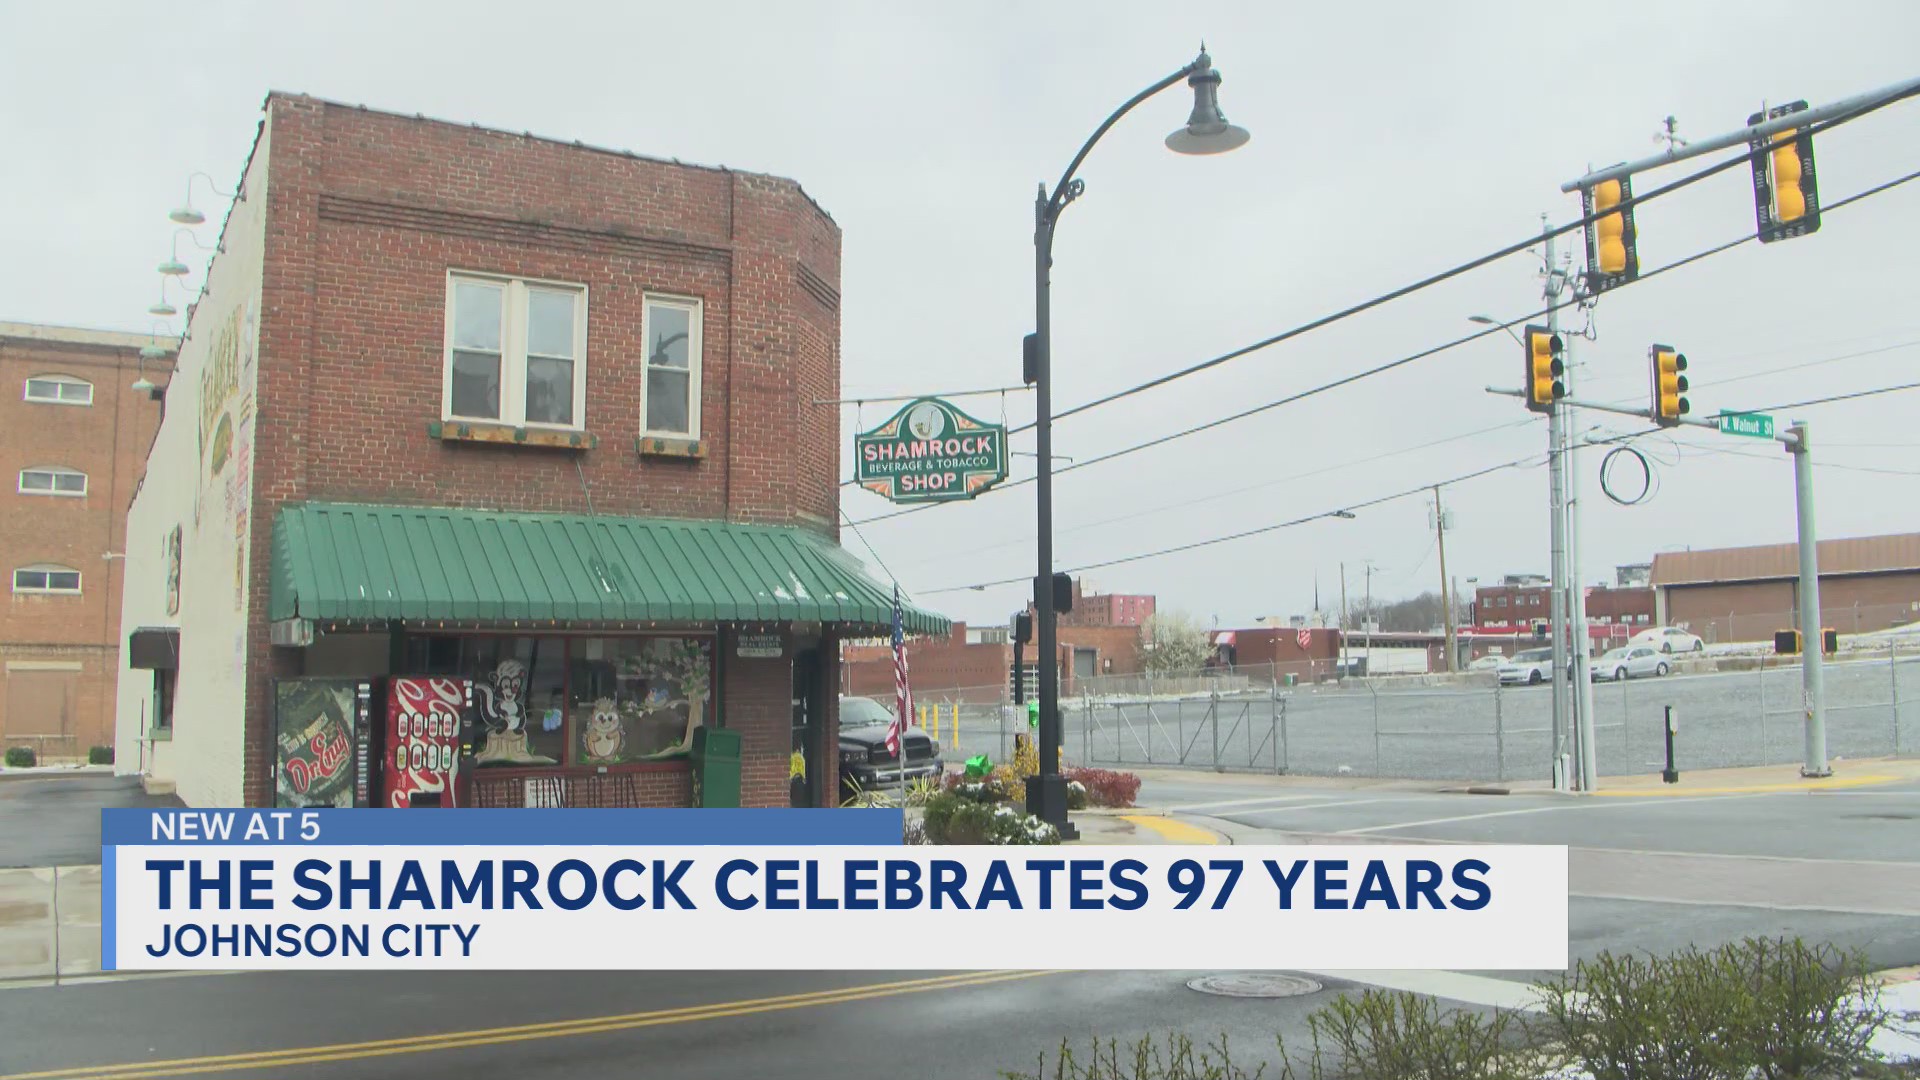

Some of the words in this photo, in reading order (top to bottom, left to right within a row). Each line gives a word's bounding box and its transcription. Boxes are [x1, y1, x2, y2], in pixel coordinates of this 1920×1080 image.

[1731, 415, 1760, 433] Walnut
[1764, 420, 1773, 435] St
[864, 436, 993, 462] SHAMROCK
[869, 461, 923, 473] BEVERAGE
[926, 460, 934, 470] &
[937, 456, 989, 468] TOBACCO
[901, 472, 957, 491] SHOP
